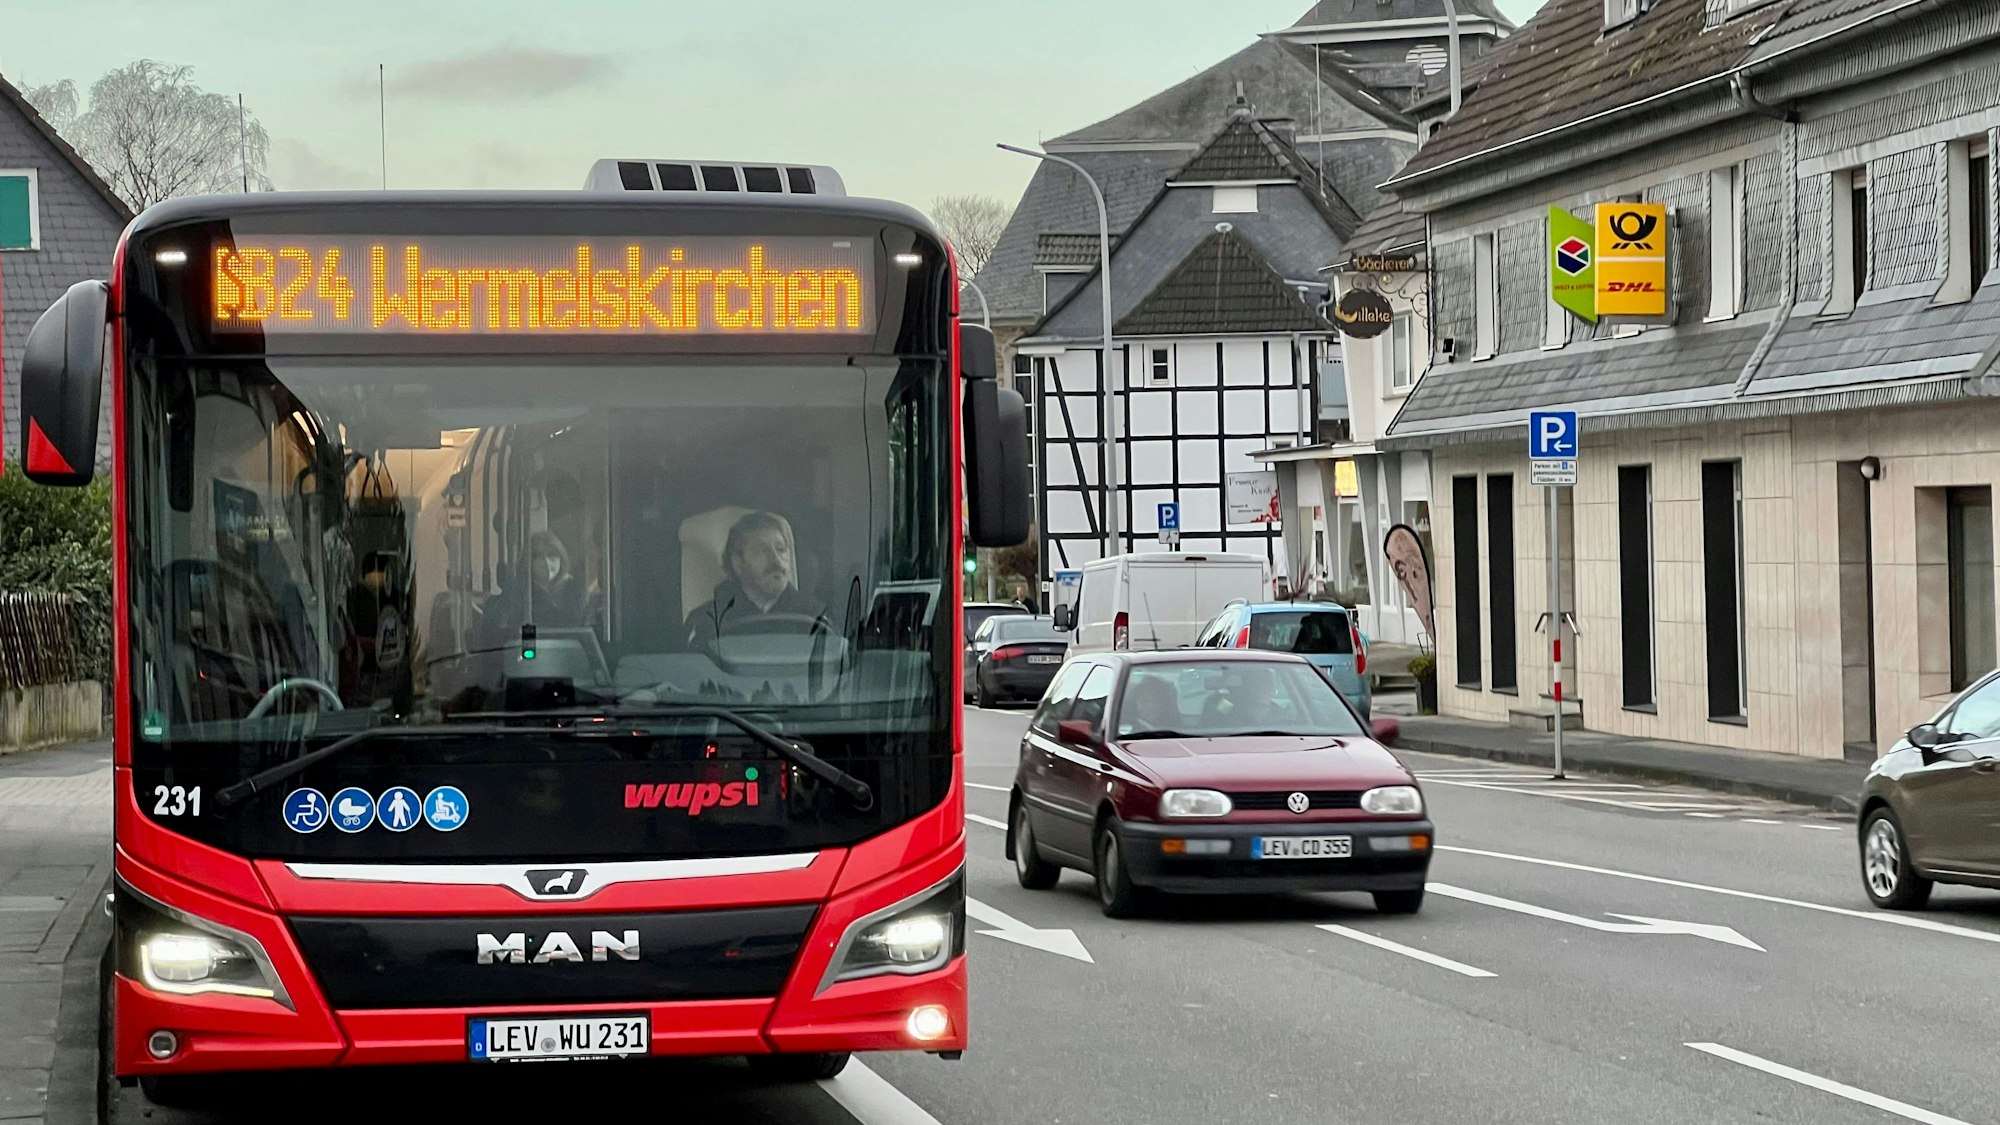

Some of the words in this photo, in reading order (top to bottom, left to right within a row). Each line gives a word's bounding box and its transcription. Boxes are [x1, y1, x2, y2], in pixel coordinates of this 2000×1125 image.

[217, 246, 354, 319] SB24
[372, 245, 859, 329] Wermelskirchen
[1607, 282, 1655, 292] DHL
[1541, 416, 1567, 453] P
[1162, 506, 1174, 527] P
[153, 784, 201, 816] 231
[624, 767, 759, 816] wupsi
[1263, 840, 1291, 855] LEV
[1302, 840, 1320, 854] CD
[1323, 839, 1350, 854] 355
[477, 930, 640, 965] MAN
[490, 1026, 538, 1052] LEV
[559, 1024, 591, 1050] WU
[598, 1022, 644, 1049] 231
